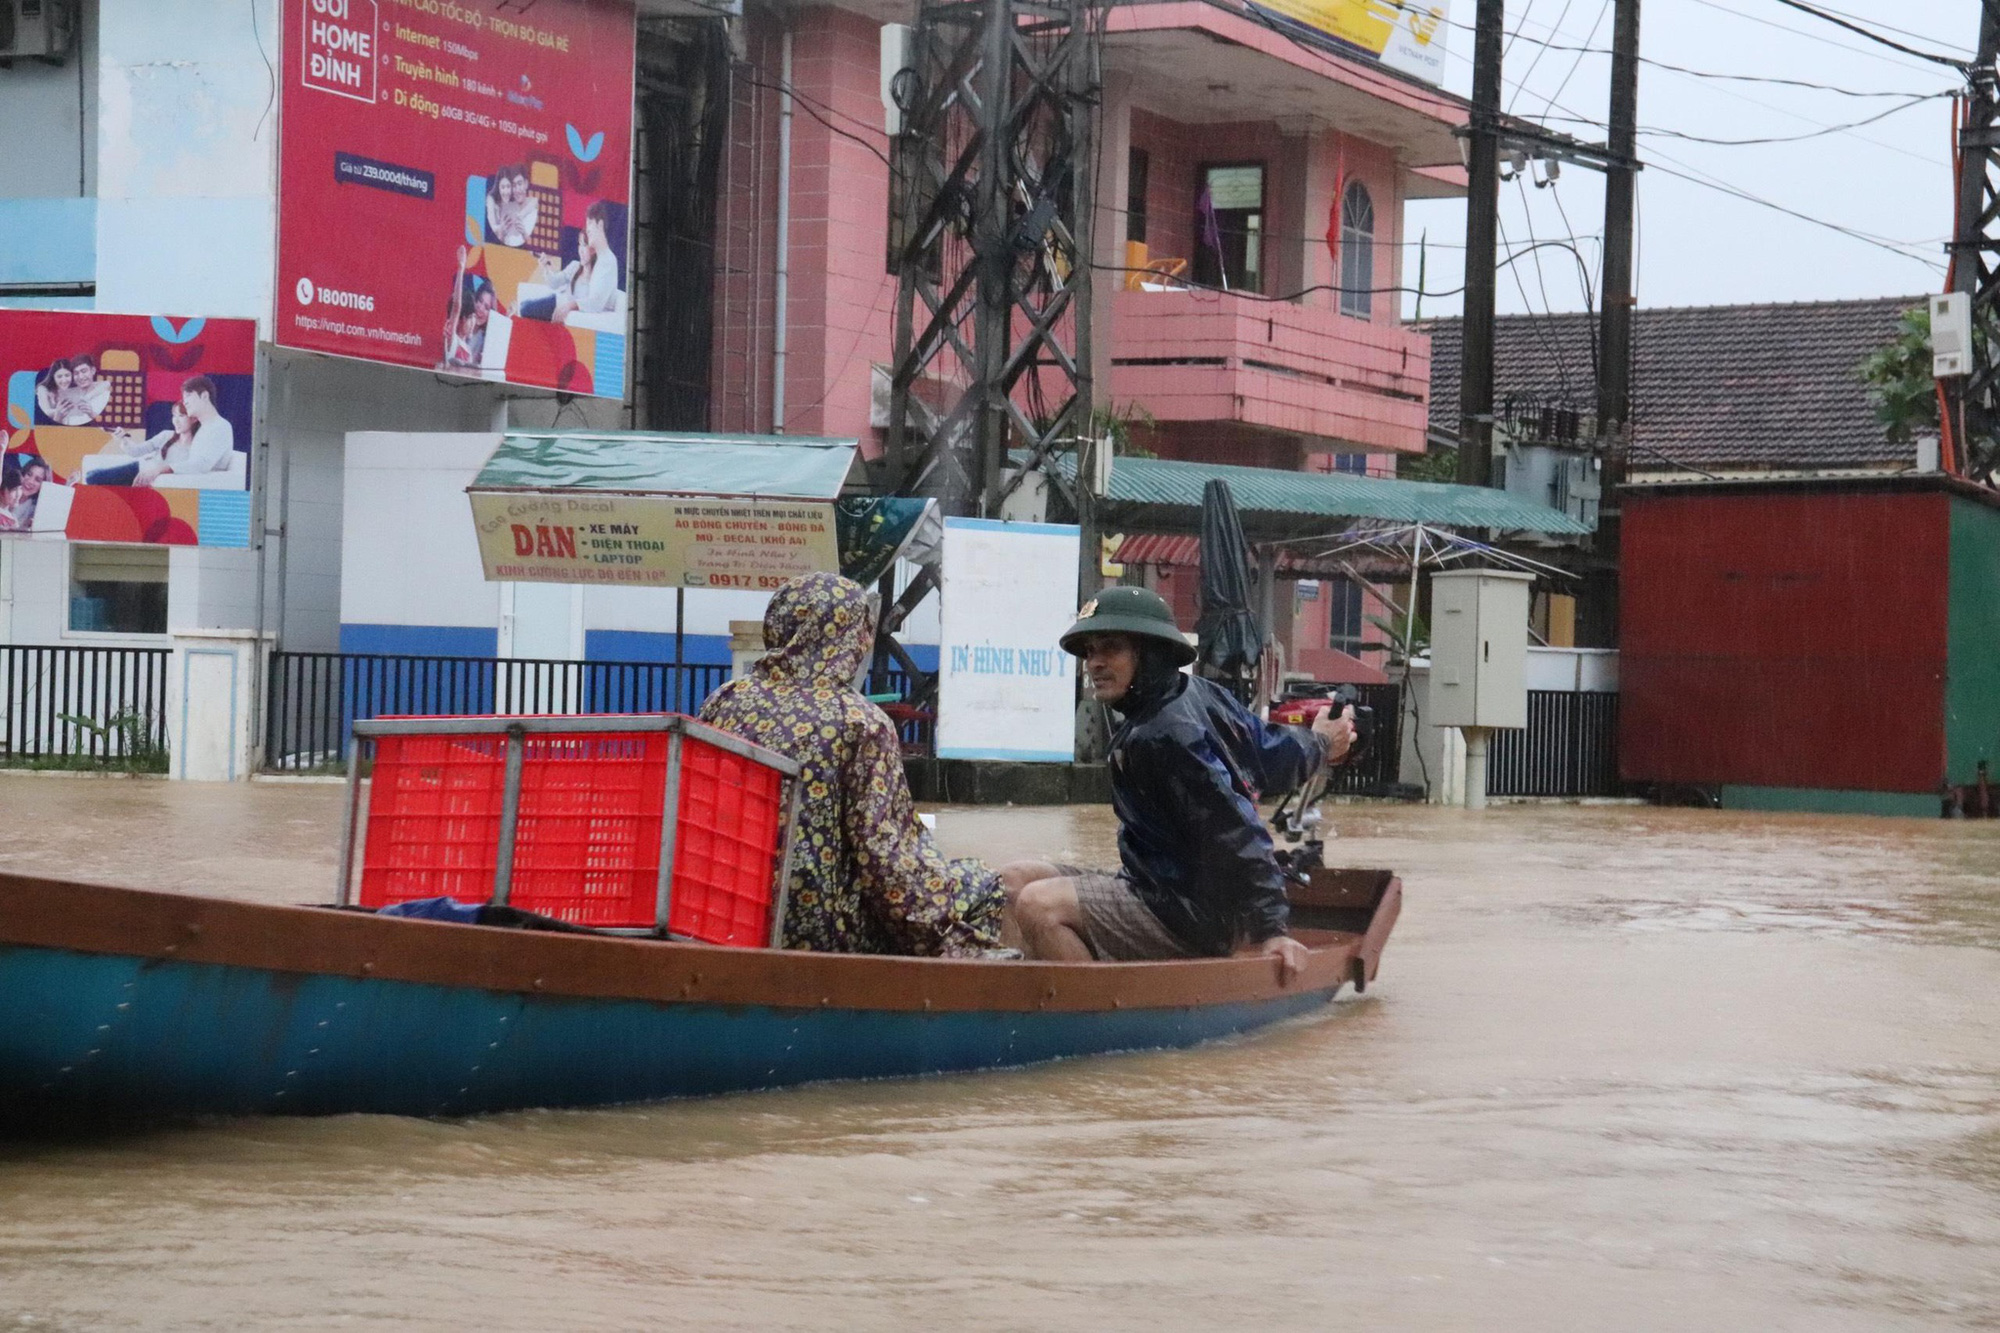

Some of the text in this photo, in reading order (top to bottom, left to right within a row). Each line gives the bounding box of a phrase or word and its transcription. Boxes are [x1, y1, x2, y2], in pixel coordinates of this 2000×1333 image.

[312, 19, 371, 58] HOME
[396, 23, 440, 49] Internet
[310, 48, 360, 88] ĐỈNH
[395, 55, 433, 81] Truyền
[435, 65, 459, 87] hình
[395, 88, 407, 106] Di
[410, 93, 439, 120] động
[318, 287, 374, 312] 18001166
[510, 517, 578, 559] DÁN
[590, 522, 638, 535] XE MÁY
[724, 534, 758, 544] DECAL
[591, 538, 664, 553] ĐIỆN THOẠI
[594, 554, 642, 564] LAPTOP
[709, 574, 752, 586] 0917
[951, 646, 969, 672] IN
